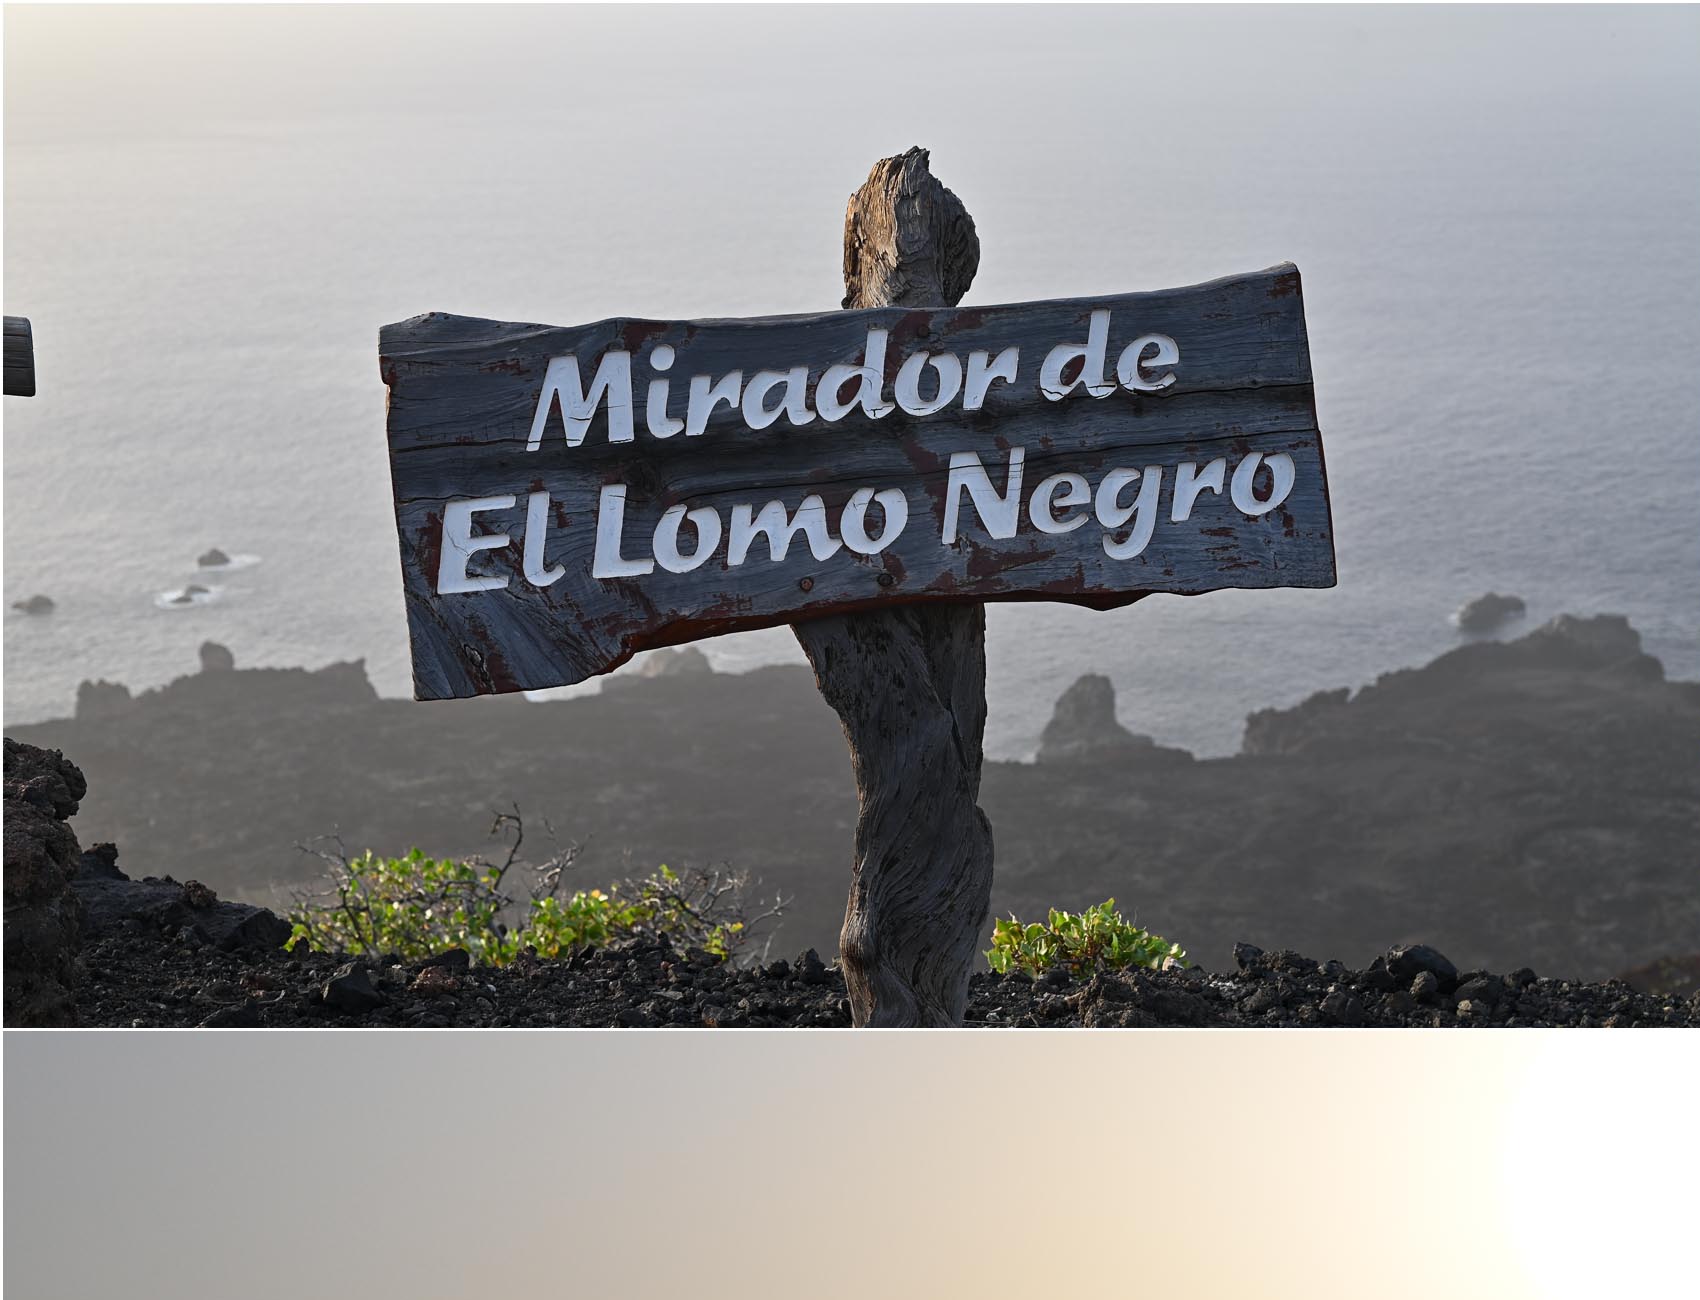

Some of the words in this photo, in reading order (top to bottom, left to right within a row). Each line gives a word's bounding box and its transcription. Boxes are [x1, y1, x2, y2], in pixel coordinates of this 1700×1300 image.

[526, 328, 1019, 452] Mirador
[1040, 307, 1178, 402] de
[436, 490, 566, 595] El
[592, 484, 909, 579] Lomo
[941, 446, 1297, 562] Negro
